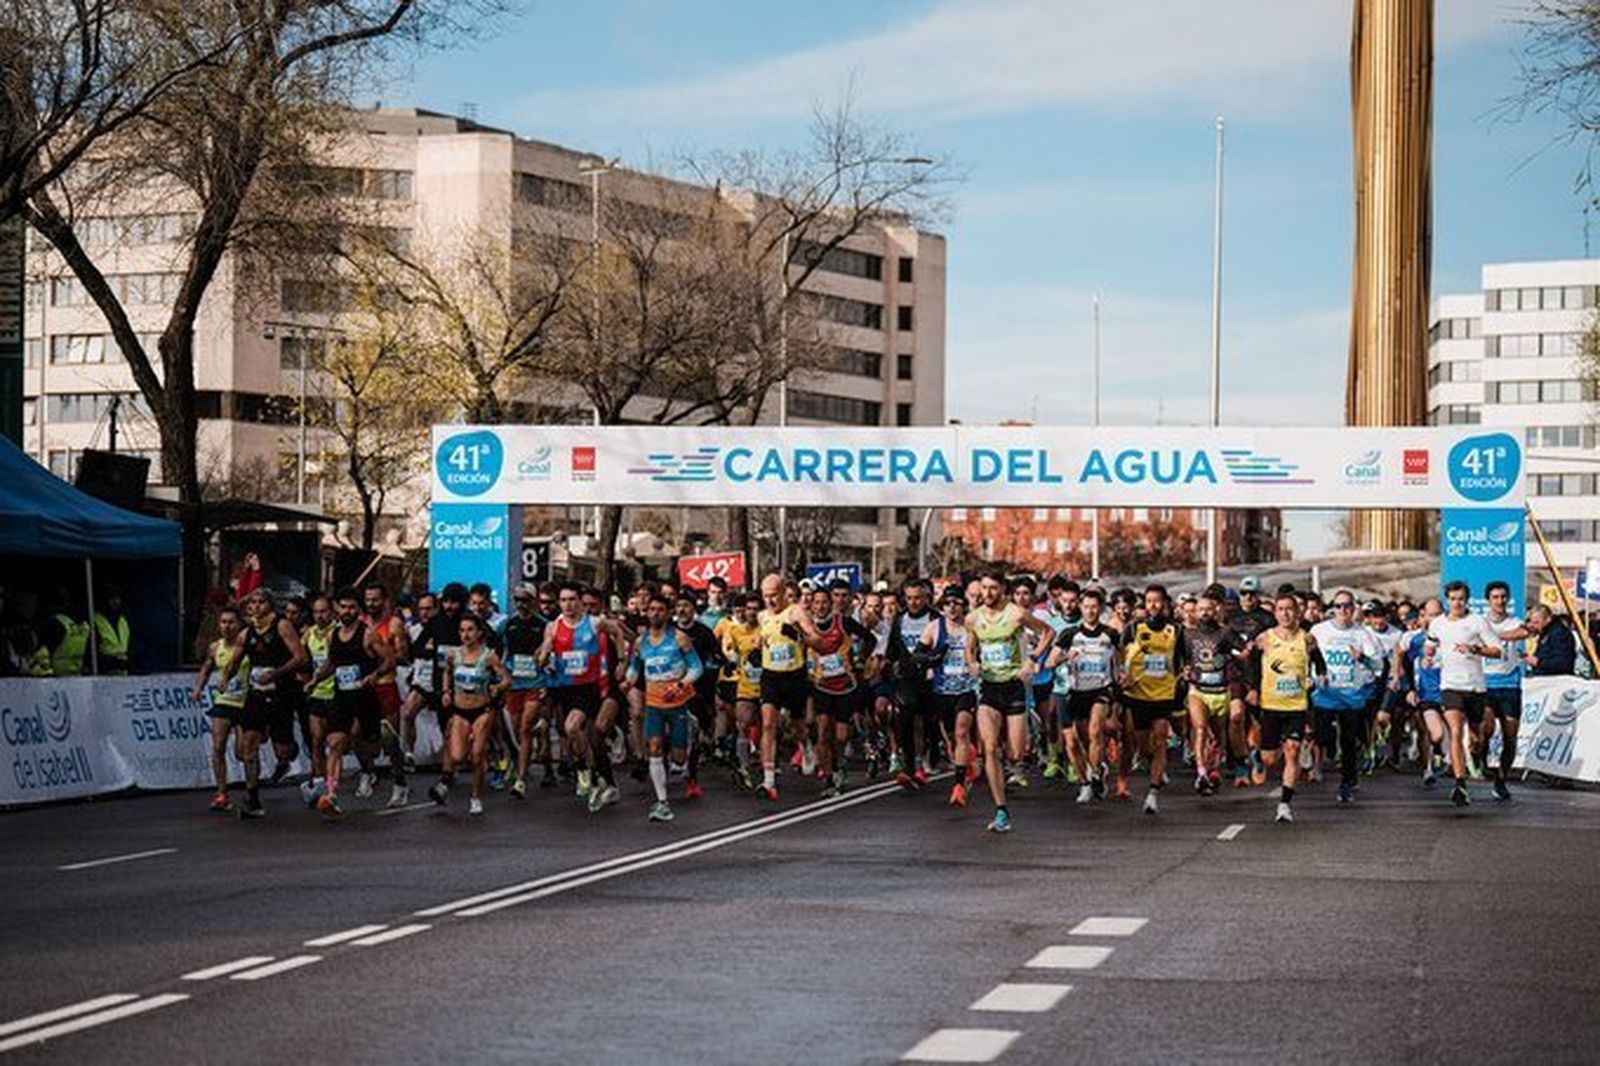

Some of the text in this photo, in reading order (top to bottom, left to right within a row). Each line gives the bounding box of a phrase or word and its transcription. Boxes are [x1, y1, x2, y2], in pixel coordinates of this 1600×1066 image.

[723, 448, 1218, 483] CARRERA DEL AGUA
[1345, 464, 1380, 477] Canal
[447, 473, 490, 484] EDICIÓN
[1460, 477, 1507, 488] EDICIÓN
[434, 521, 473, 535] Canal
[1446, 527, 1487, 541] Canal
[434, 537, 453, 549] de
[454, 537, 491, 549] Isabel
[1446, 543, 1465, 556] de
[1468, 543, 1509, 556] Isabel
[1326, 649, 1356, 666] 202
[2, 704, 47, 746] Canal
[131, 716, 211, 741] DEL AGUA
[13, 752, 36, 789] de
